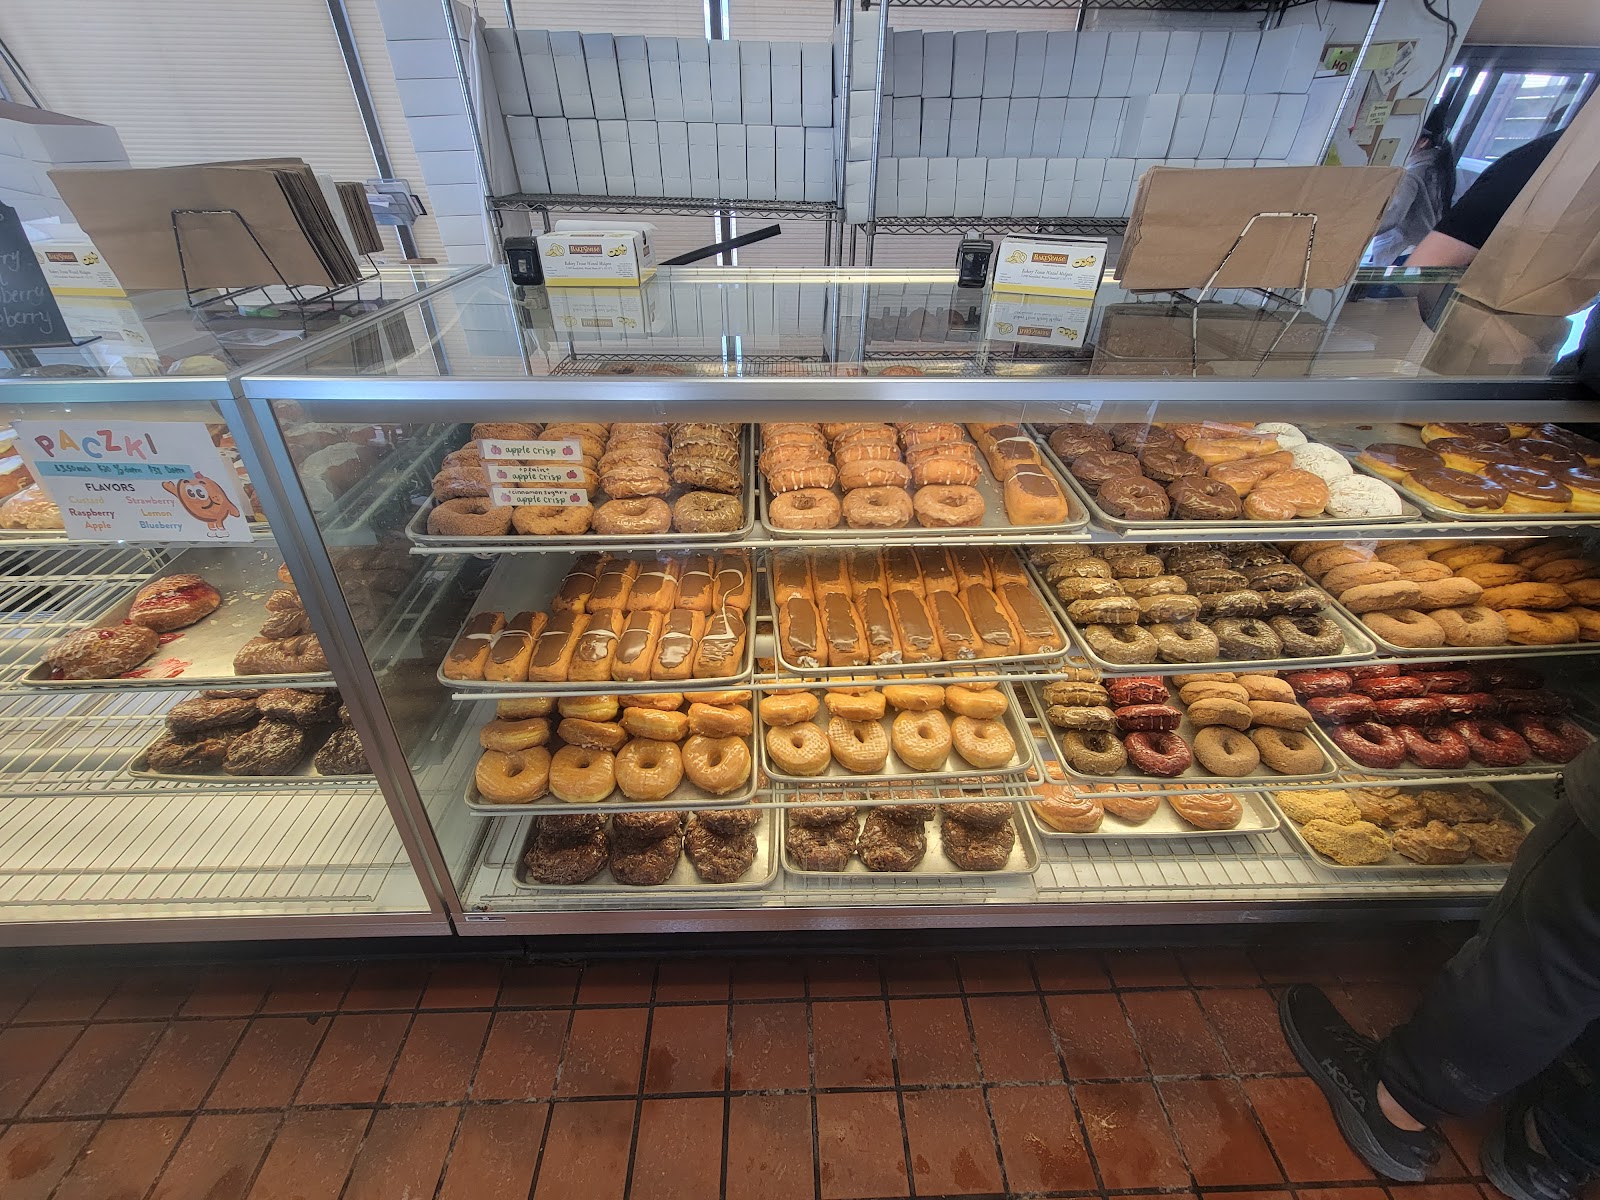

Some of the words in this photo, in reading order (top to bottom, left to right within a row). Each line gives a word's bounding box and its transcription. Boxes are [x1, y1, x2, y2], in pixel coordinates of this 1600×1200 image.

[34, 429, 158, 460] PACZKI
[505, 445, 531, 456] apple
[532, 446, 557, 456] crisp
[512, 473, 537, 482] apple
[539, 473, 562, 482] crisp
[85, 483, 136, 492] FLAVORS
[68, 496, 104, 504] Custard
[125, 496, 175, 507] Strawberry
[516, 495, 542, 505] apple
[543, 496, 566, 505] crisp
[68, 508, 115, 519] Raspberry
[140, 508, 172, 517] Lemon
[85, 521, 112, 531] Apple
[139, 520, 182, 532] Blueberry
[1320, 1057, 1367, 1112] HOKA
